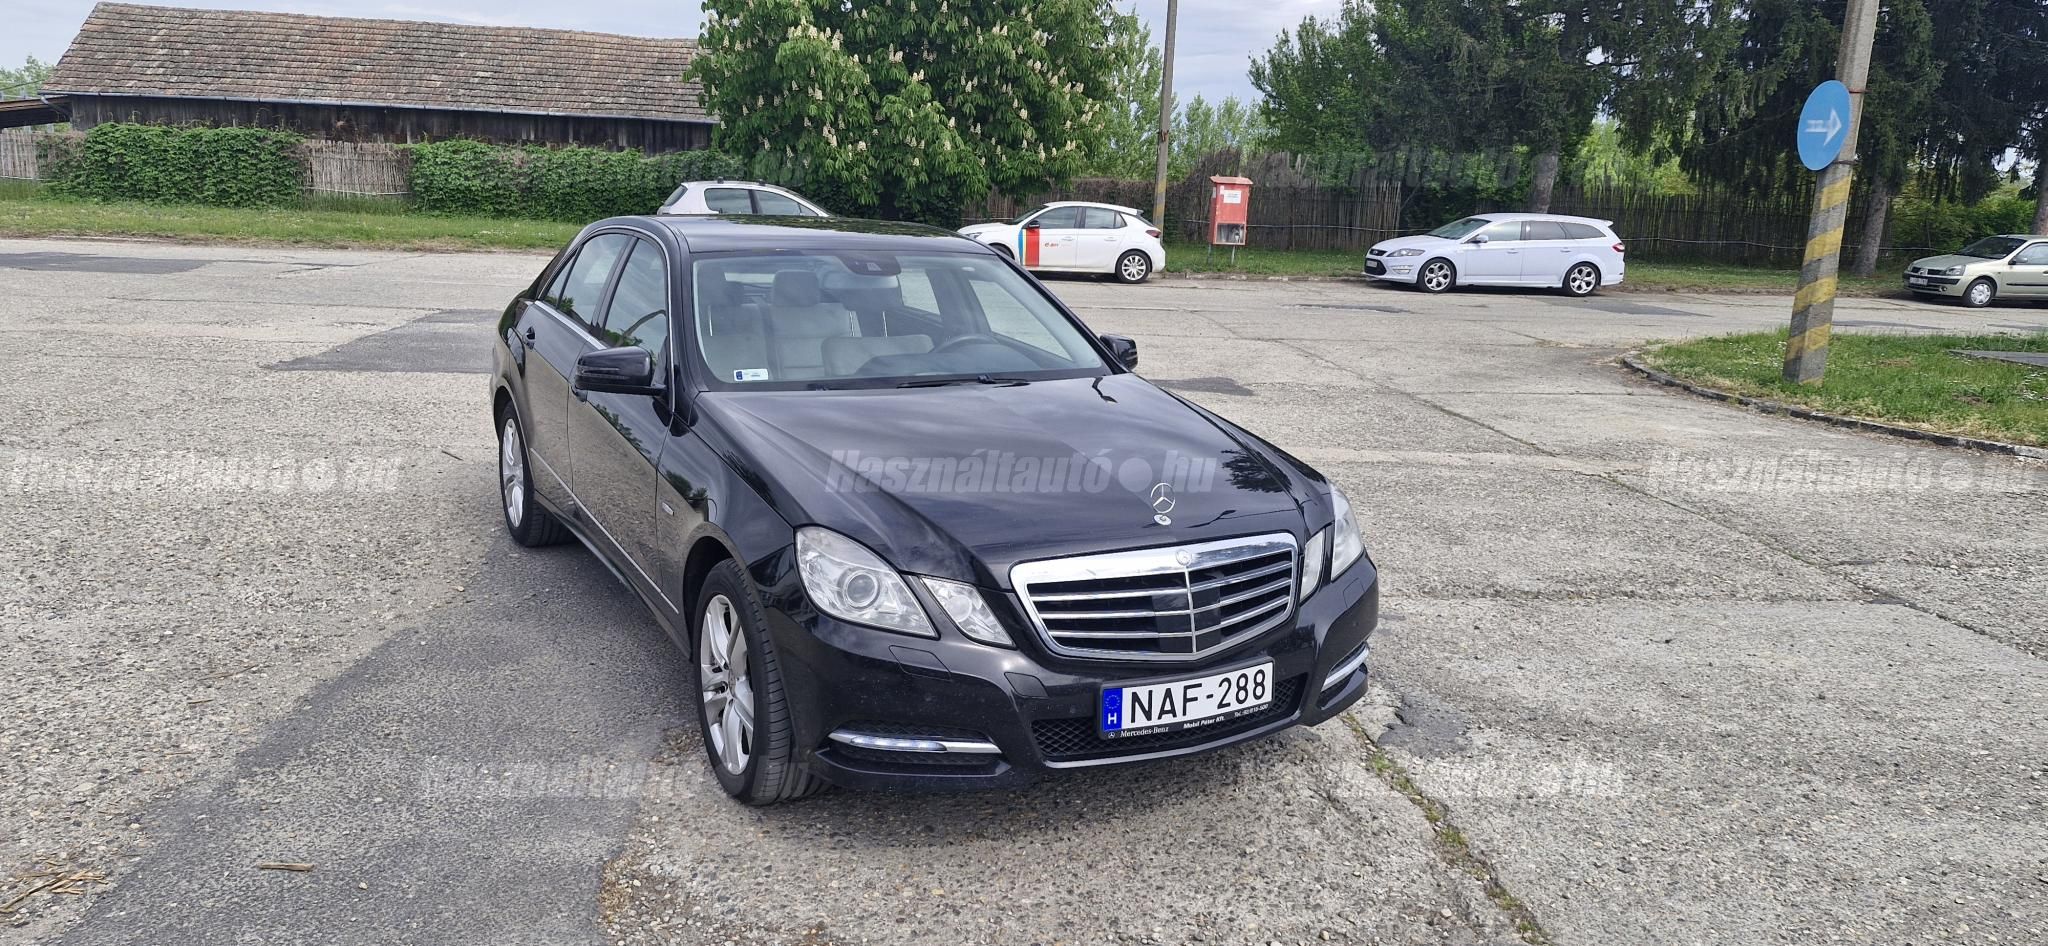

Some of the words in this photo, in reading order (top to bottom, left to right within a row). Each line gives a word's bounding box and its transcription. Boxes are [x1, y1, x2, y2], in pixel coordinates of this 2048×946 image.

[1130, 669, 1266, 724] NAF-288
[1107, 712, 1118, 725] H
[1120, 726, 1169, 738] Mercedes-Benz
